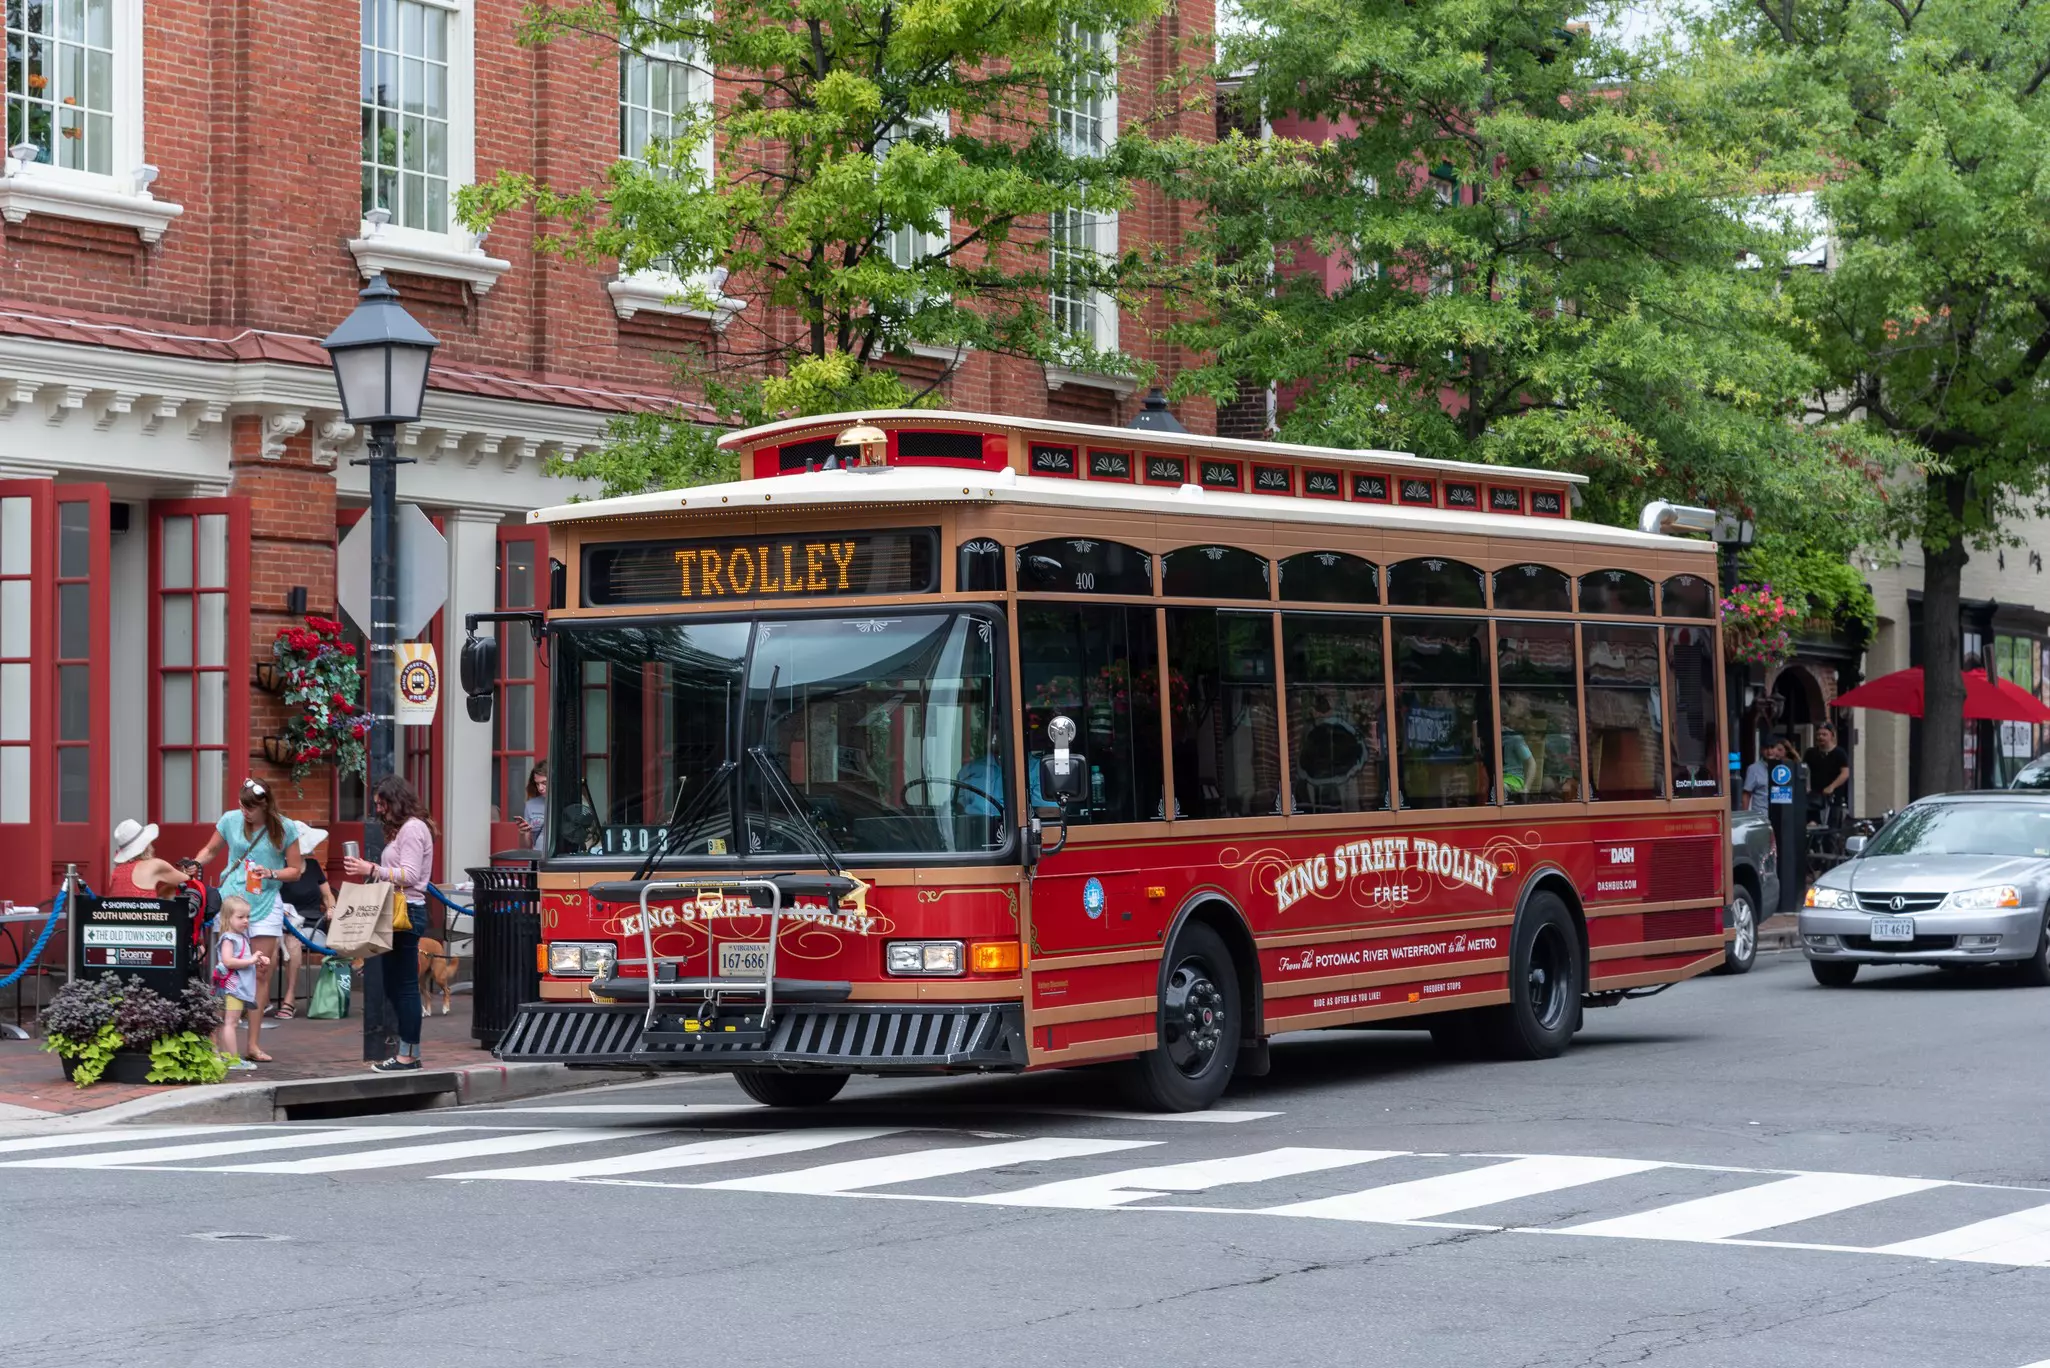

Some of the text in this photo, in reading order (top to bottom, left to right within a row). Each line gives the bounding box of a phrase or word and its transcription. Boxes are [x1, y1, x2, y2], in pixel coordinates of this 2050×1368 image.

[675, 542, 856, 597] TROLLEY
[1076, 572, 1094, 590] 400
[405, 662, 423, 674] STREET
[424, 663, 435, 690] TROLLEY
[1777, 768, 1787, 781] P
[1611, 847, 1635, 864] DASH
[1273, 836, 1499, 914] KING STREET TROLLEY
[1373, 885, 1409, 903] FREE
[1597, 879, 1637, 892] DASHBUS.COM
[108, 901, 136, 909] SHOPPING
[139, 902, 160, 910] DINING
[682, 897, 762, 921] STREE
[92, 911, 169, 921] SOUTH UNION STREET
[95, 929, 166, 942] THE OLD TOWN SHOP
[120, 948, 154, 959] Braemar
[733, 944, 761, 952] VIRGINIA
[1278, 933, 1497, 972] From the POTOMAC RIVER WATERFRONT to the METRO
[1423, 981, 1462, 994] FREQUENT STOPS
[1313, 991, 1381, 1008] RIDE AS OFTEN AS YOU LIKE!
